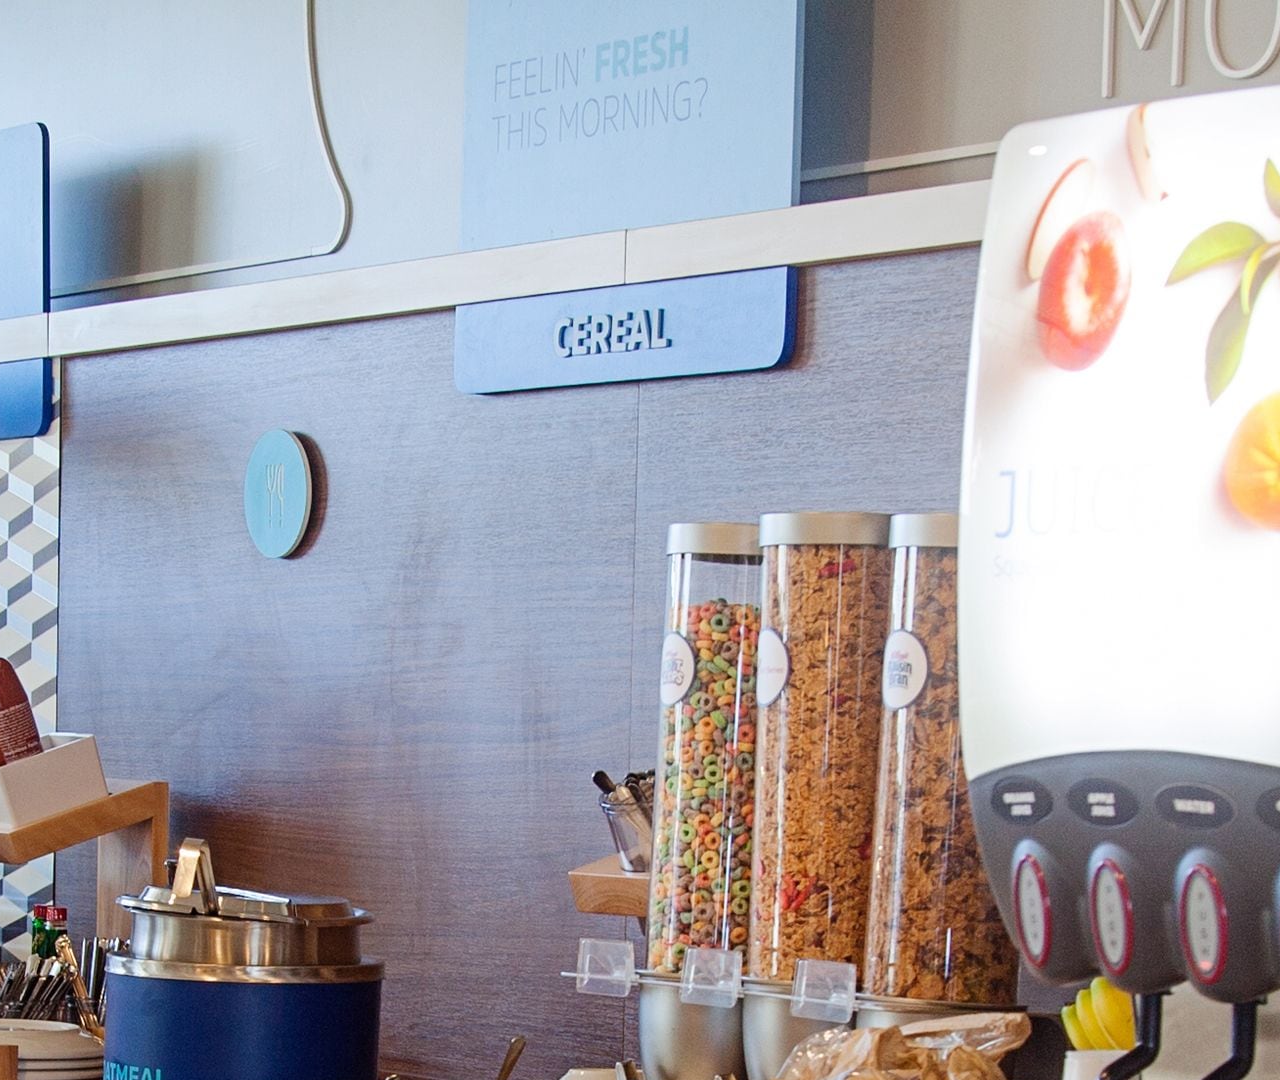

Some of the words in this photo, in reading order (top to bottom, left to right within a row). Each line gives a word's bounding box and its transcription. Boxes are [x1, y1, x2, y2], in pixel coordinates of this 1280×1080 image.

[494, 47, 586, 103] FEELIN'
[593, 25, 689, 83] FRESH
[491, 106, 548, 153] THIS
[559, 76, 709, 142] MORNING?
[553, 307, 671, 358] CEREAL
